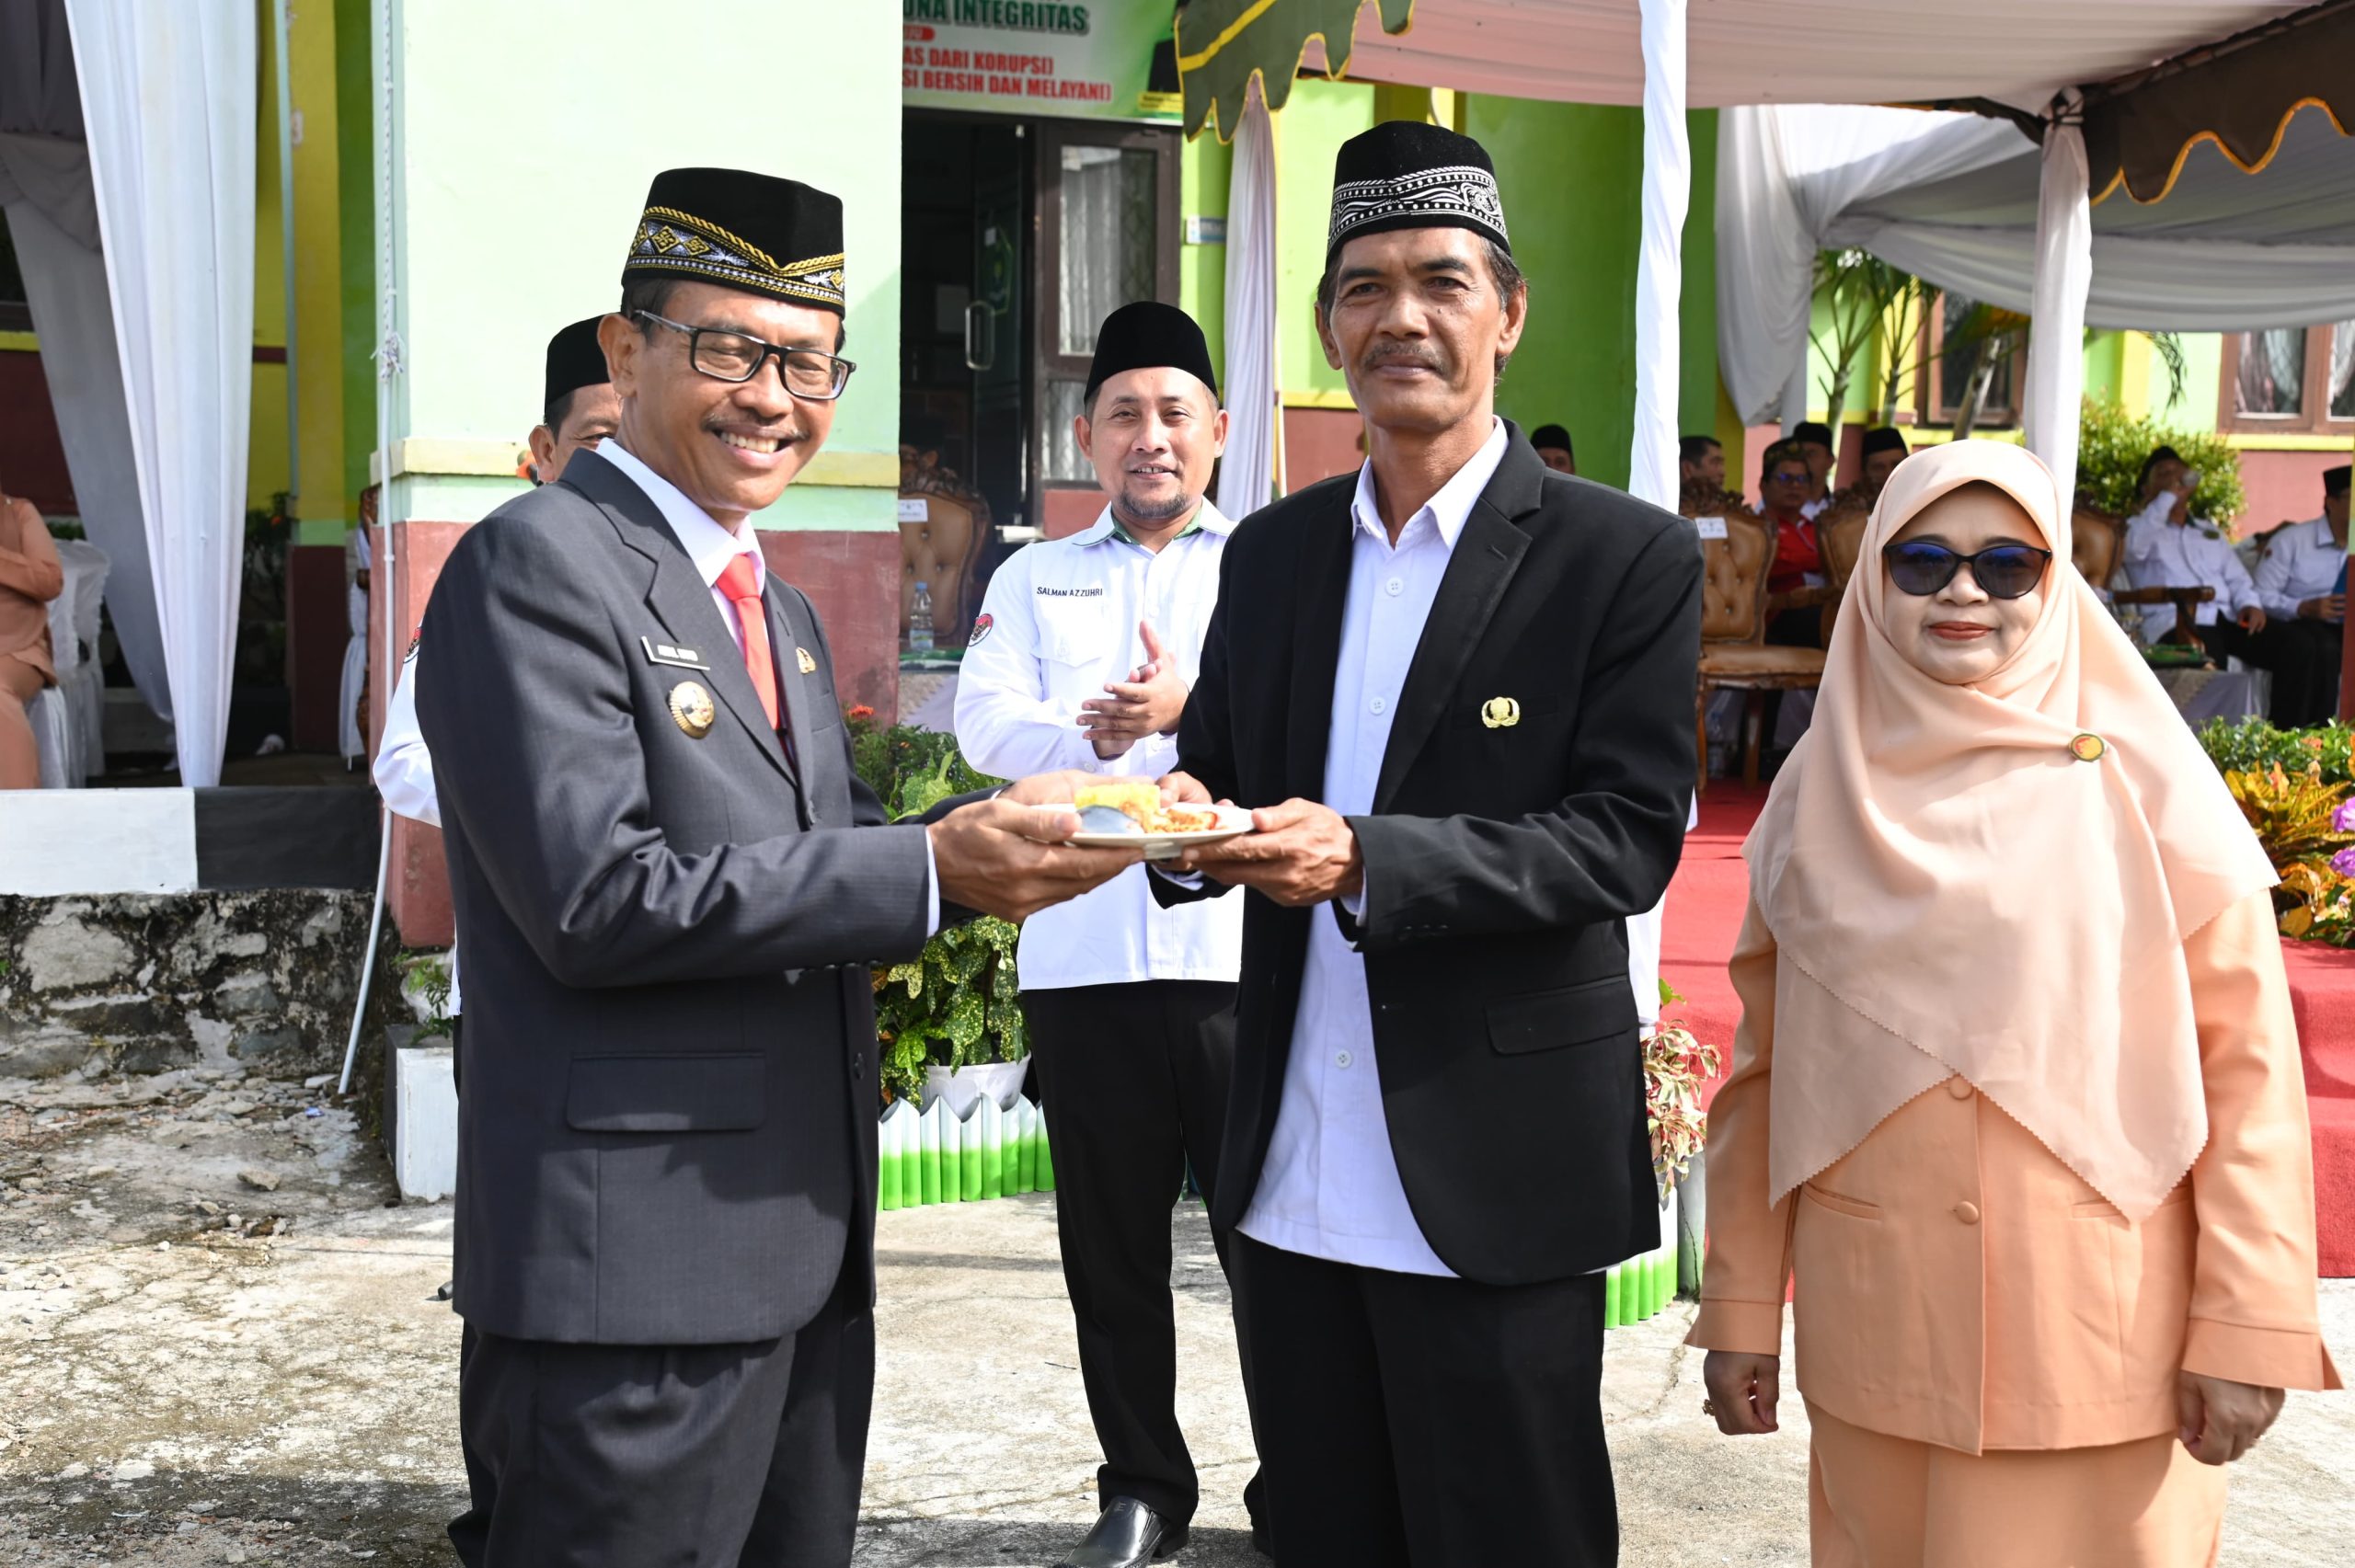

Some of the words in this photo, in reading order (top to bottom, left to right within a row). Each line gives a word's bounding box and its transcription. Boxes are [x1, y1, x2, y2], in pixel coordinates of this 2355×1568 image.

[955, 0, 1089, 32] INTEGRITAS
[929, 48, 969, 69] DARI
[924, 70, 984, 92] BERSIH
[989, 75, 1022, 95] DAN
[1037, 587, 1067, 597] SALMAN
[1069, 588, 1103, 597] AZZUHRI
